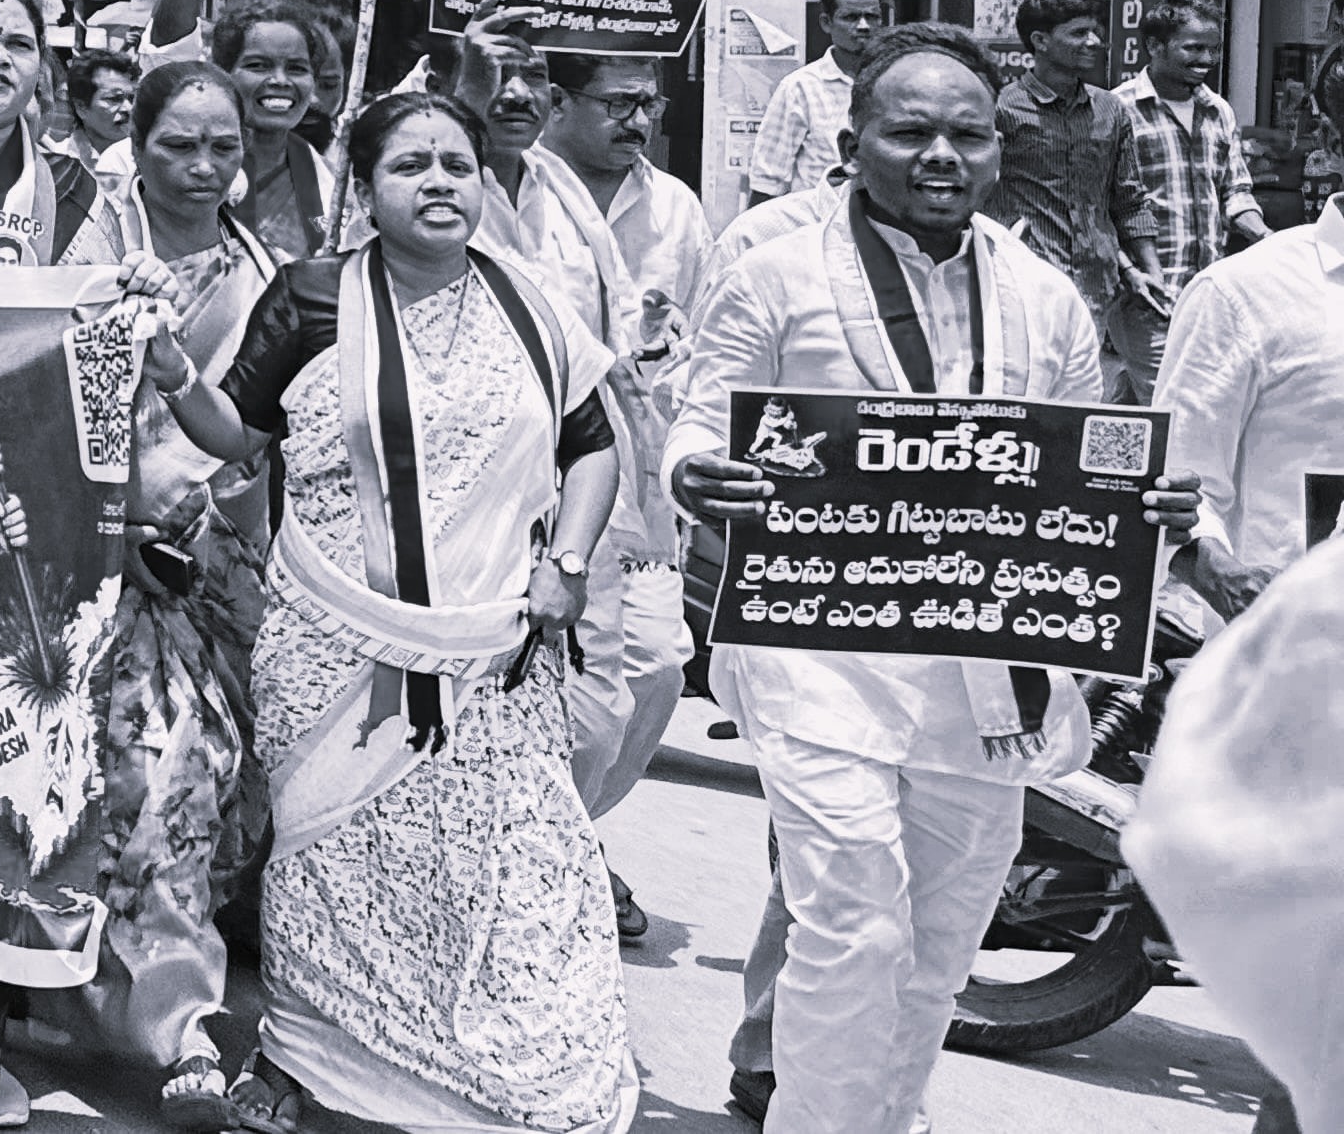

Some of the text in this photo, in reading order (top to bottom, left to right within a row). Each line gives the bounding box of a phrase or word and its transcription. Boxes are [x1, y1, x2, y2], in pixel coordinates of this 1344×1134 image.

[856, 400, 1027, 421] చంద్రబాబు వెన్నుపోటుకు
[856, 422, 1041, 488] రెండేళ్లు
[766, 500, 1118, 548] పంటకు గిట్టుబాటు లేదు!
[735, 551, 1122, 608] రైతును ఆదుకోలేని ప్రభుత్వం
[740, 593, 1122, 651] ఉంటే ఎంత ఊడితే ఎంత?
